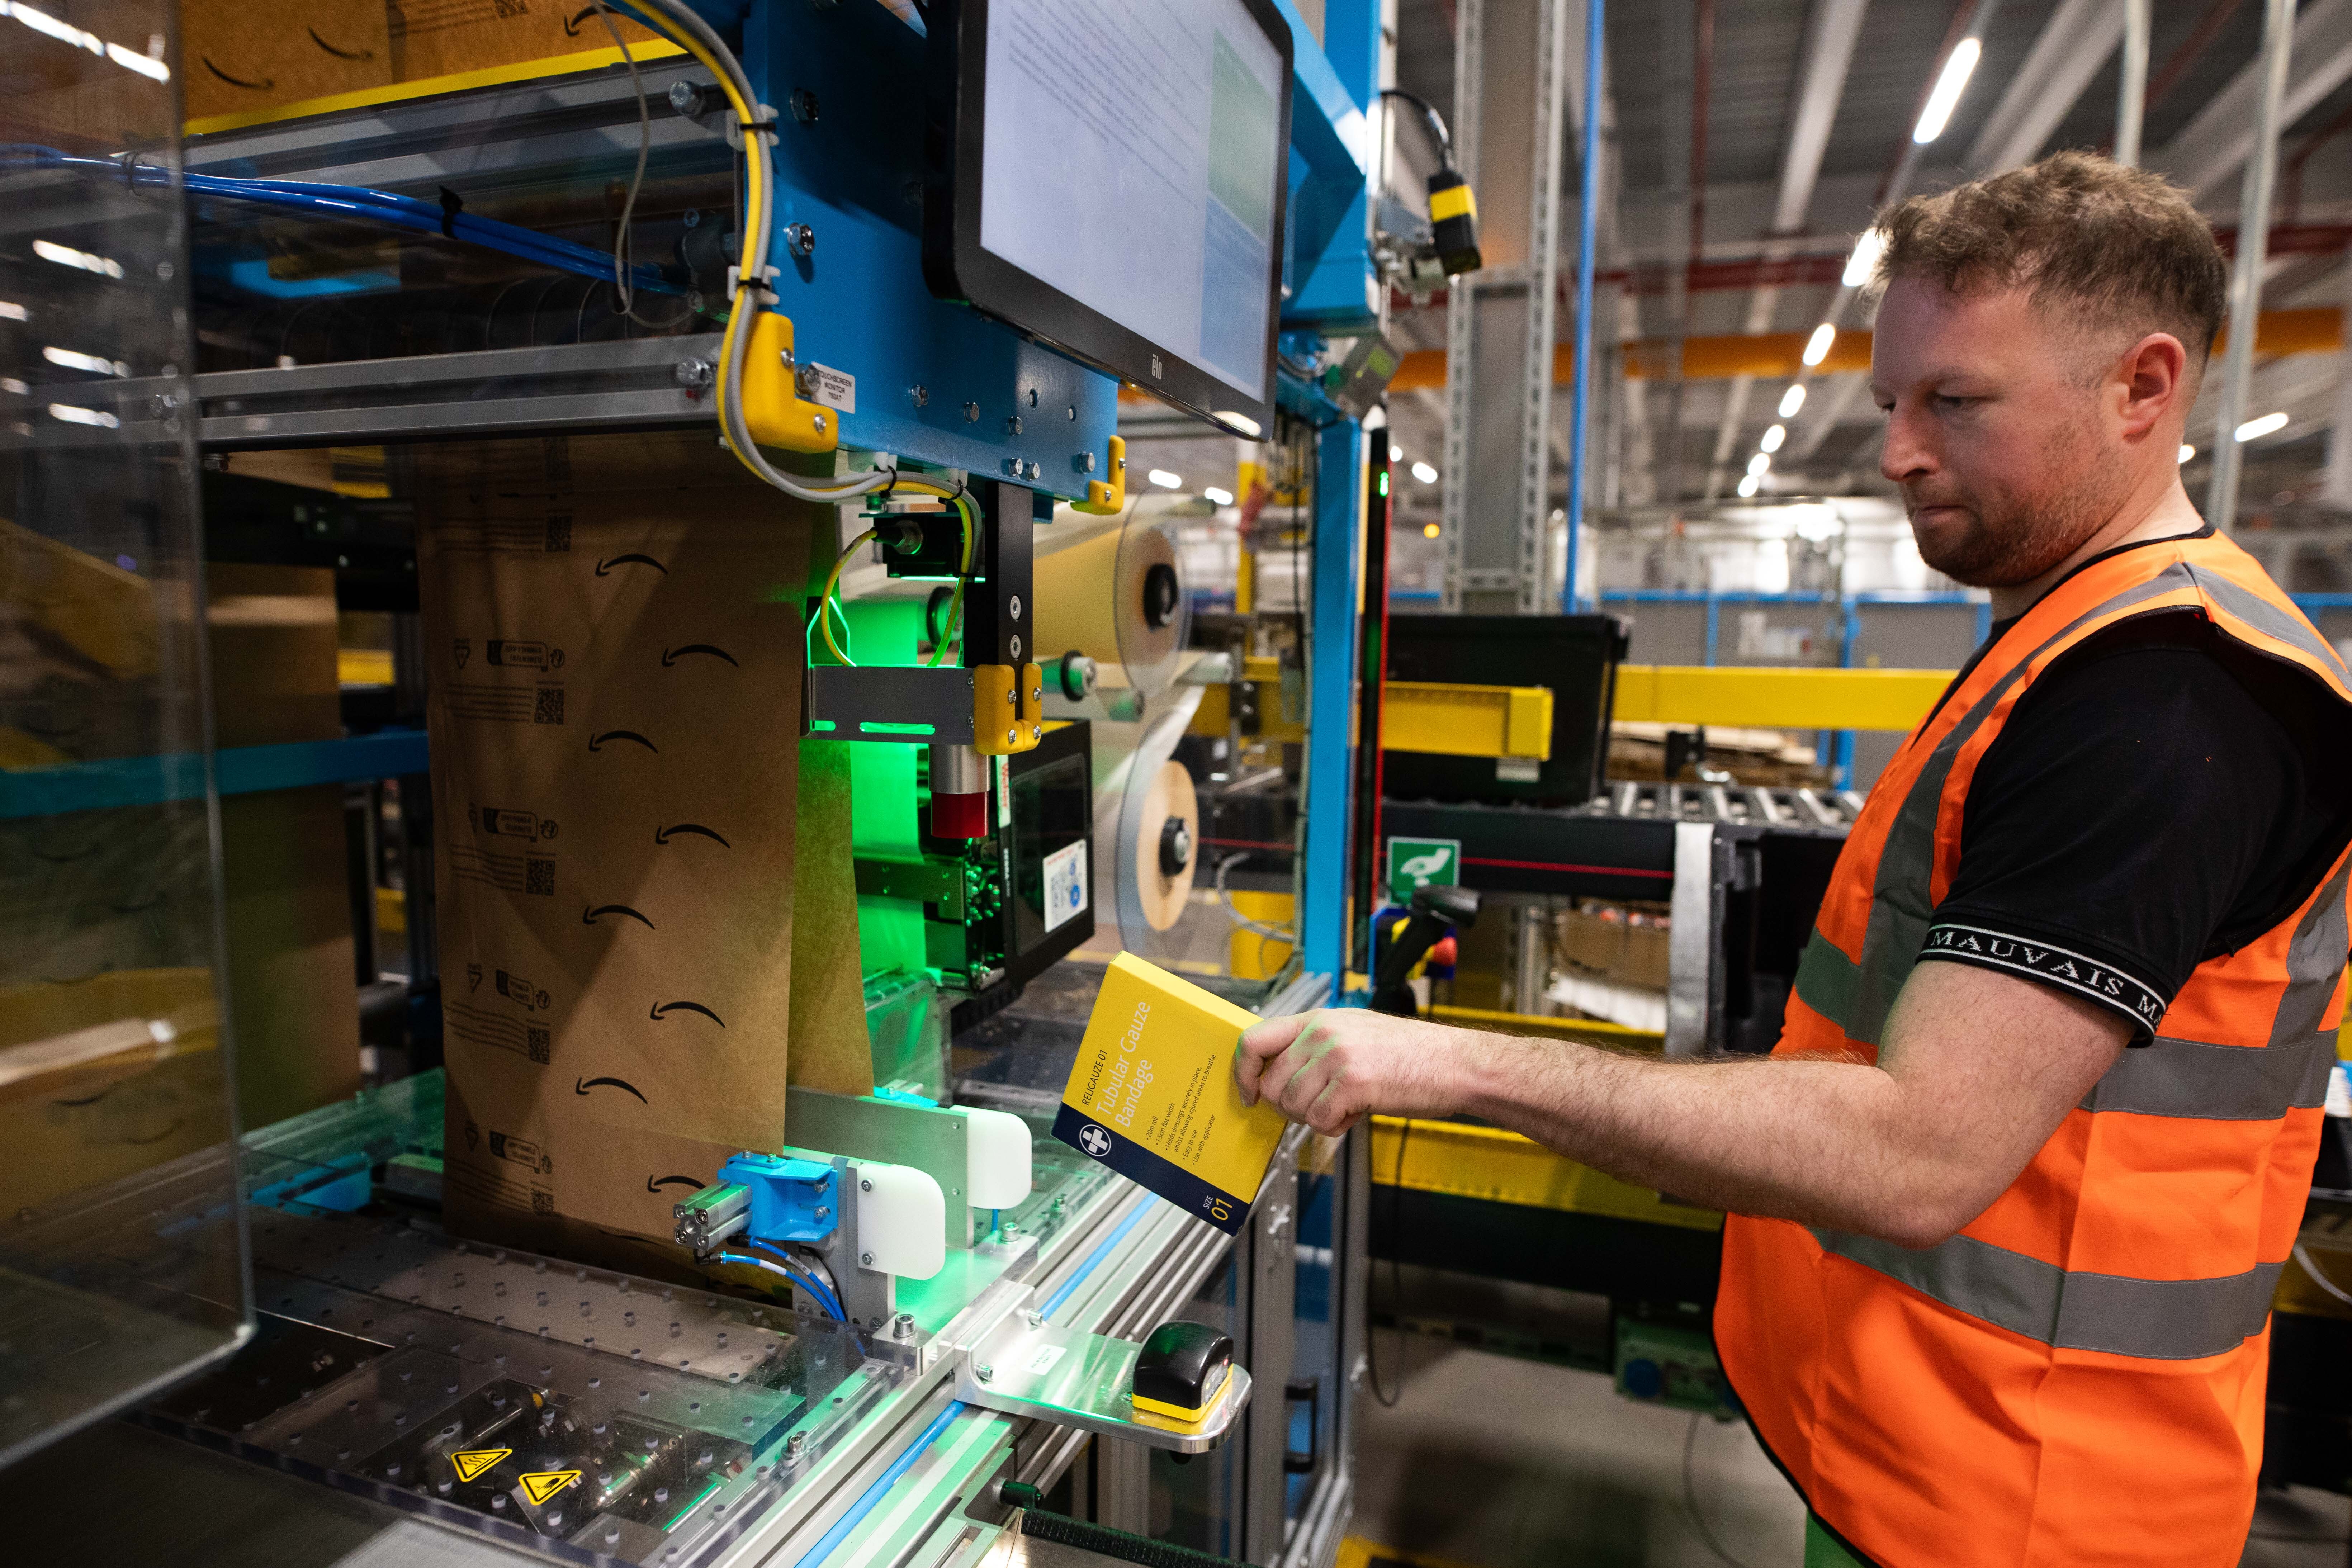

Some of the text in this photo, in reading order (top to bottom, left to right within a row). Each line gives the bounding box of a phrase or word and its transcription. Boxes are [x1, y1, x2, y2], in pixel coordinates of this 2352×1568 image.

[1930, 932, 2124, 995] MAUVAIS
[1082, 1050, 1107, 1106] RELIGAUZE 01
[1096, 1001, 1150, 1115] Tubular Gauze
[1115, 1060, 1153, 1127] Bandage
[1166, 1133, 1175, 1147] Holds
[1172, 1109, 1185, 1132] dressings
[1182, 1087, 1193, 1109] securely
[1192, 1067, 1202, 1083] place,
[1166, 1103, 1175, 1118] width
[1174, 1137, 1183, 1152] whilst
[1180, 1114, 1193, 1136] allowing
[1188, 1096, 1199, 1115] injured
[1196, 1082, 1205, 1096] areas
[1203, 1054, 1216, 1075] breathe
[1183, 1146, 1192, 1157] Easy
[1203, 1114, 1216, 1141] applicator
[1203, 1195, 1213, 1209] SIZE
[1211, 1198, 1232, 1220] 01
